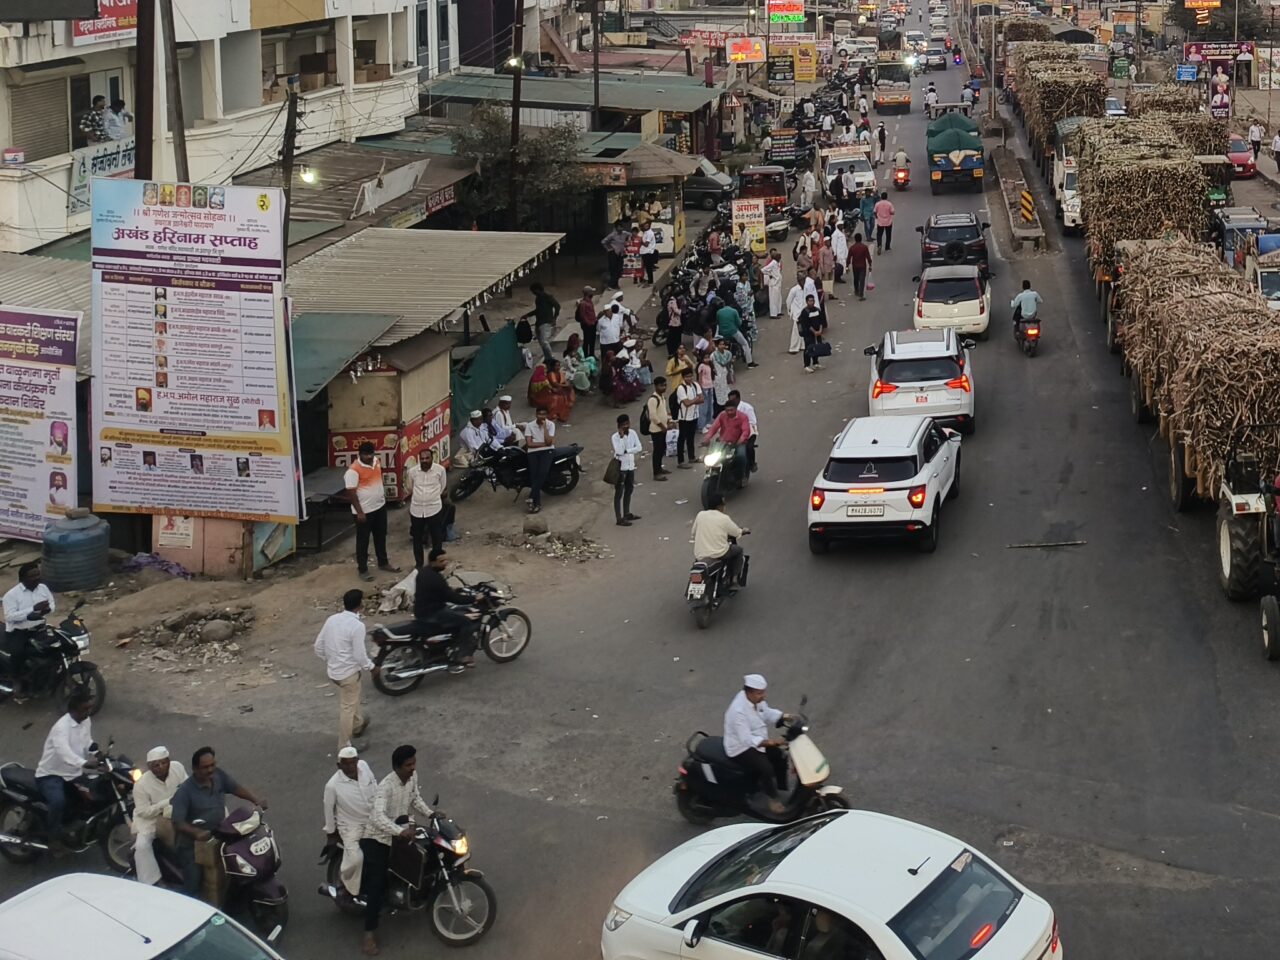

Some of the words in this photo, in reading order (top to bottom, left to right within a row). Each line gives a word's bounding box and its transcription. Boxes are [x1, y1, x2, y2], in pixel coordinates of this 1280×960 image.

[112, 226, 149, 240] अखंड
[153, 226, 205, 245] हरिनाम
[209, 234, 259, 250] सप्ताह
